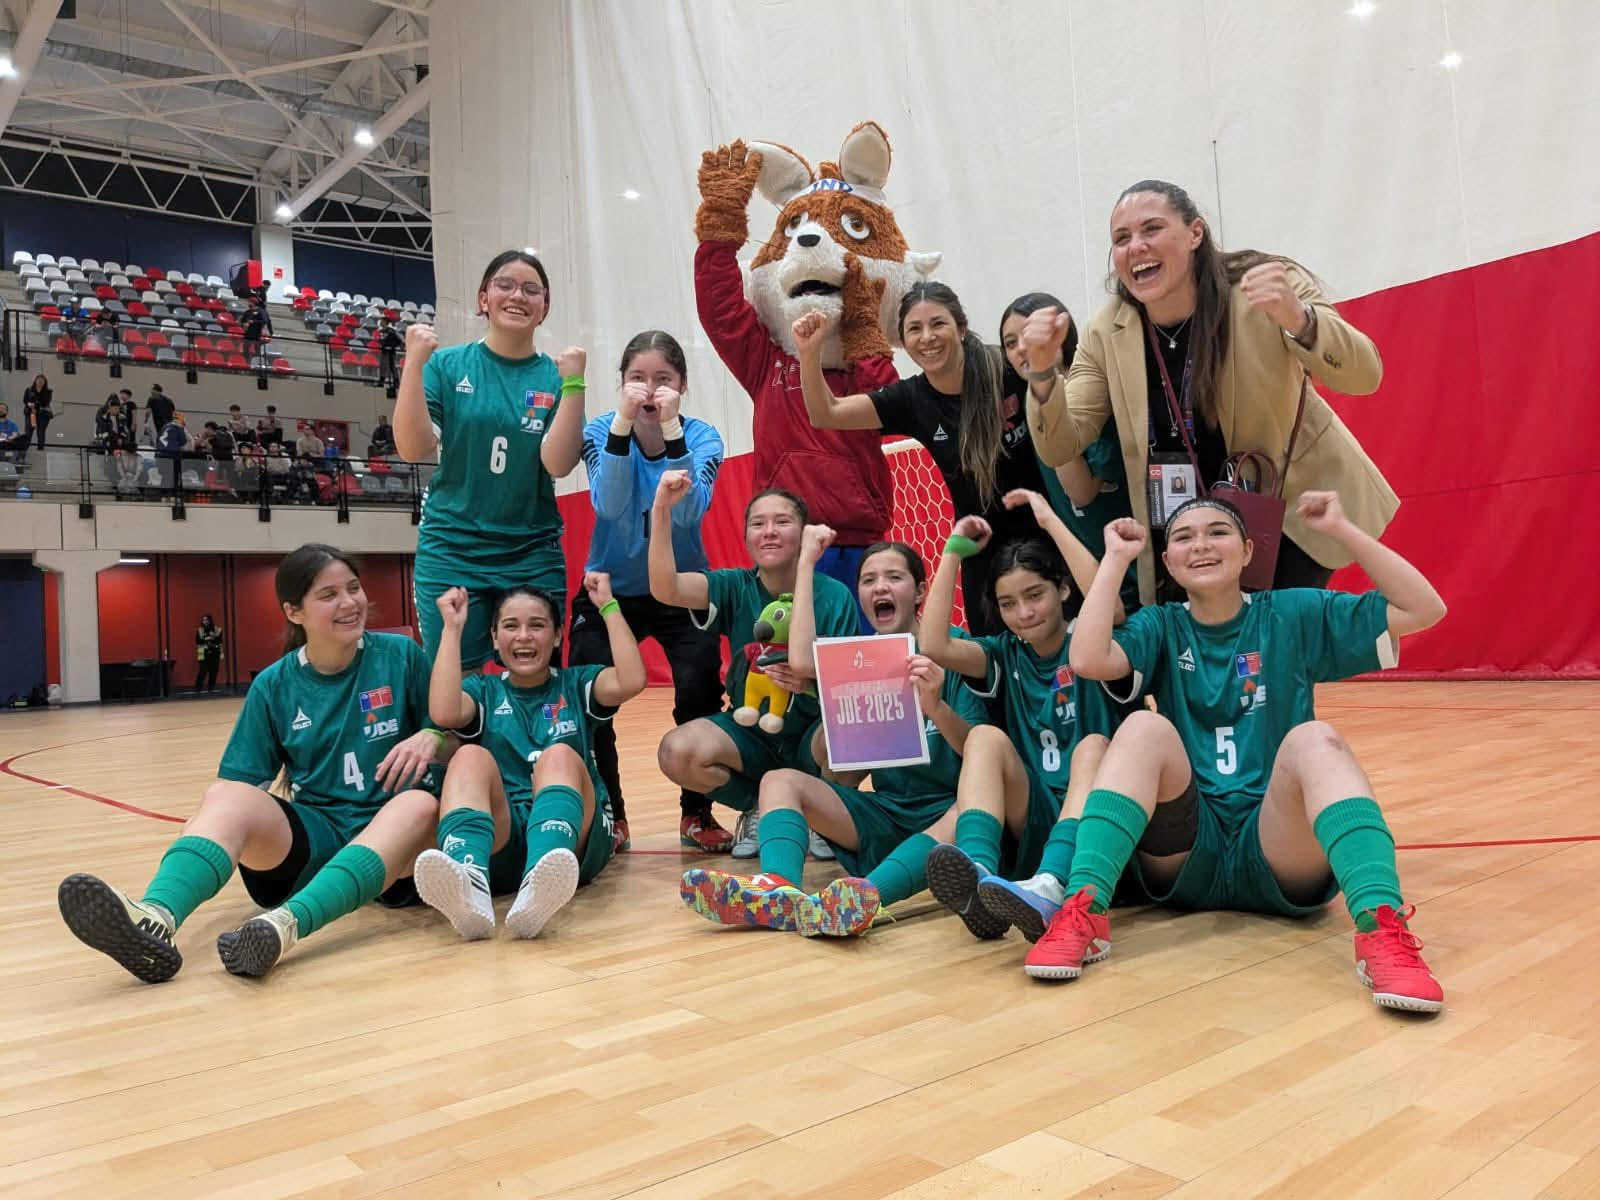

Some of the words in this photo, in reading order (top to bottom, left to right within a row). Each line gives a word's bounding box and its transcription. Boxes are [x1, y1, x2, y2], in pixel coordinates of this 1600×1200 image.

[489, 436, 508, 474] 6
[836, 694, 863, 725] JDE
[864, 691, 905, 723] 2025
[369, 718, 399, 738] JDE
[1040, 729, 1061, 772] 8
[1215, 726, 1237, 775] 5
[343, 751, 365, 791] 4
